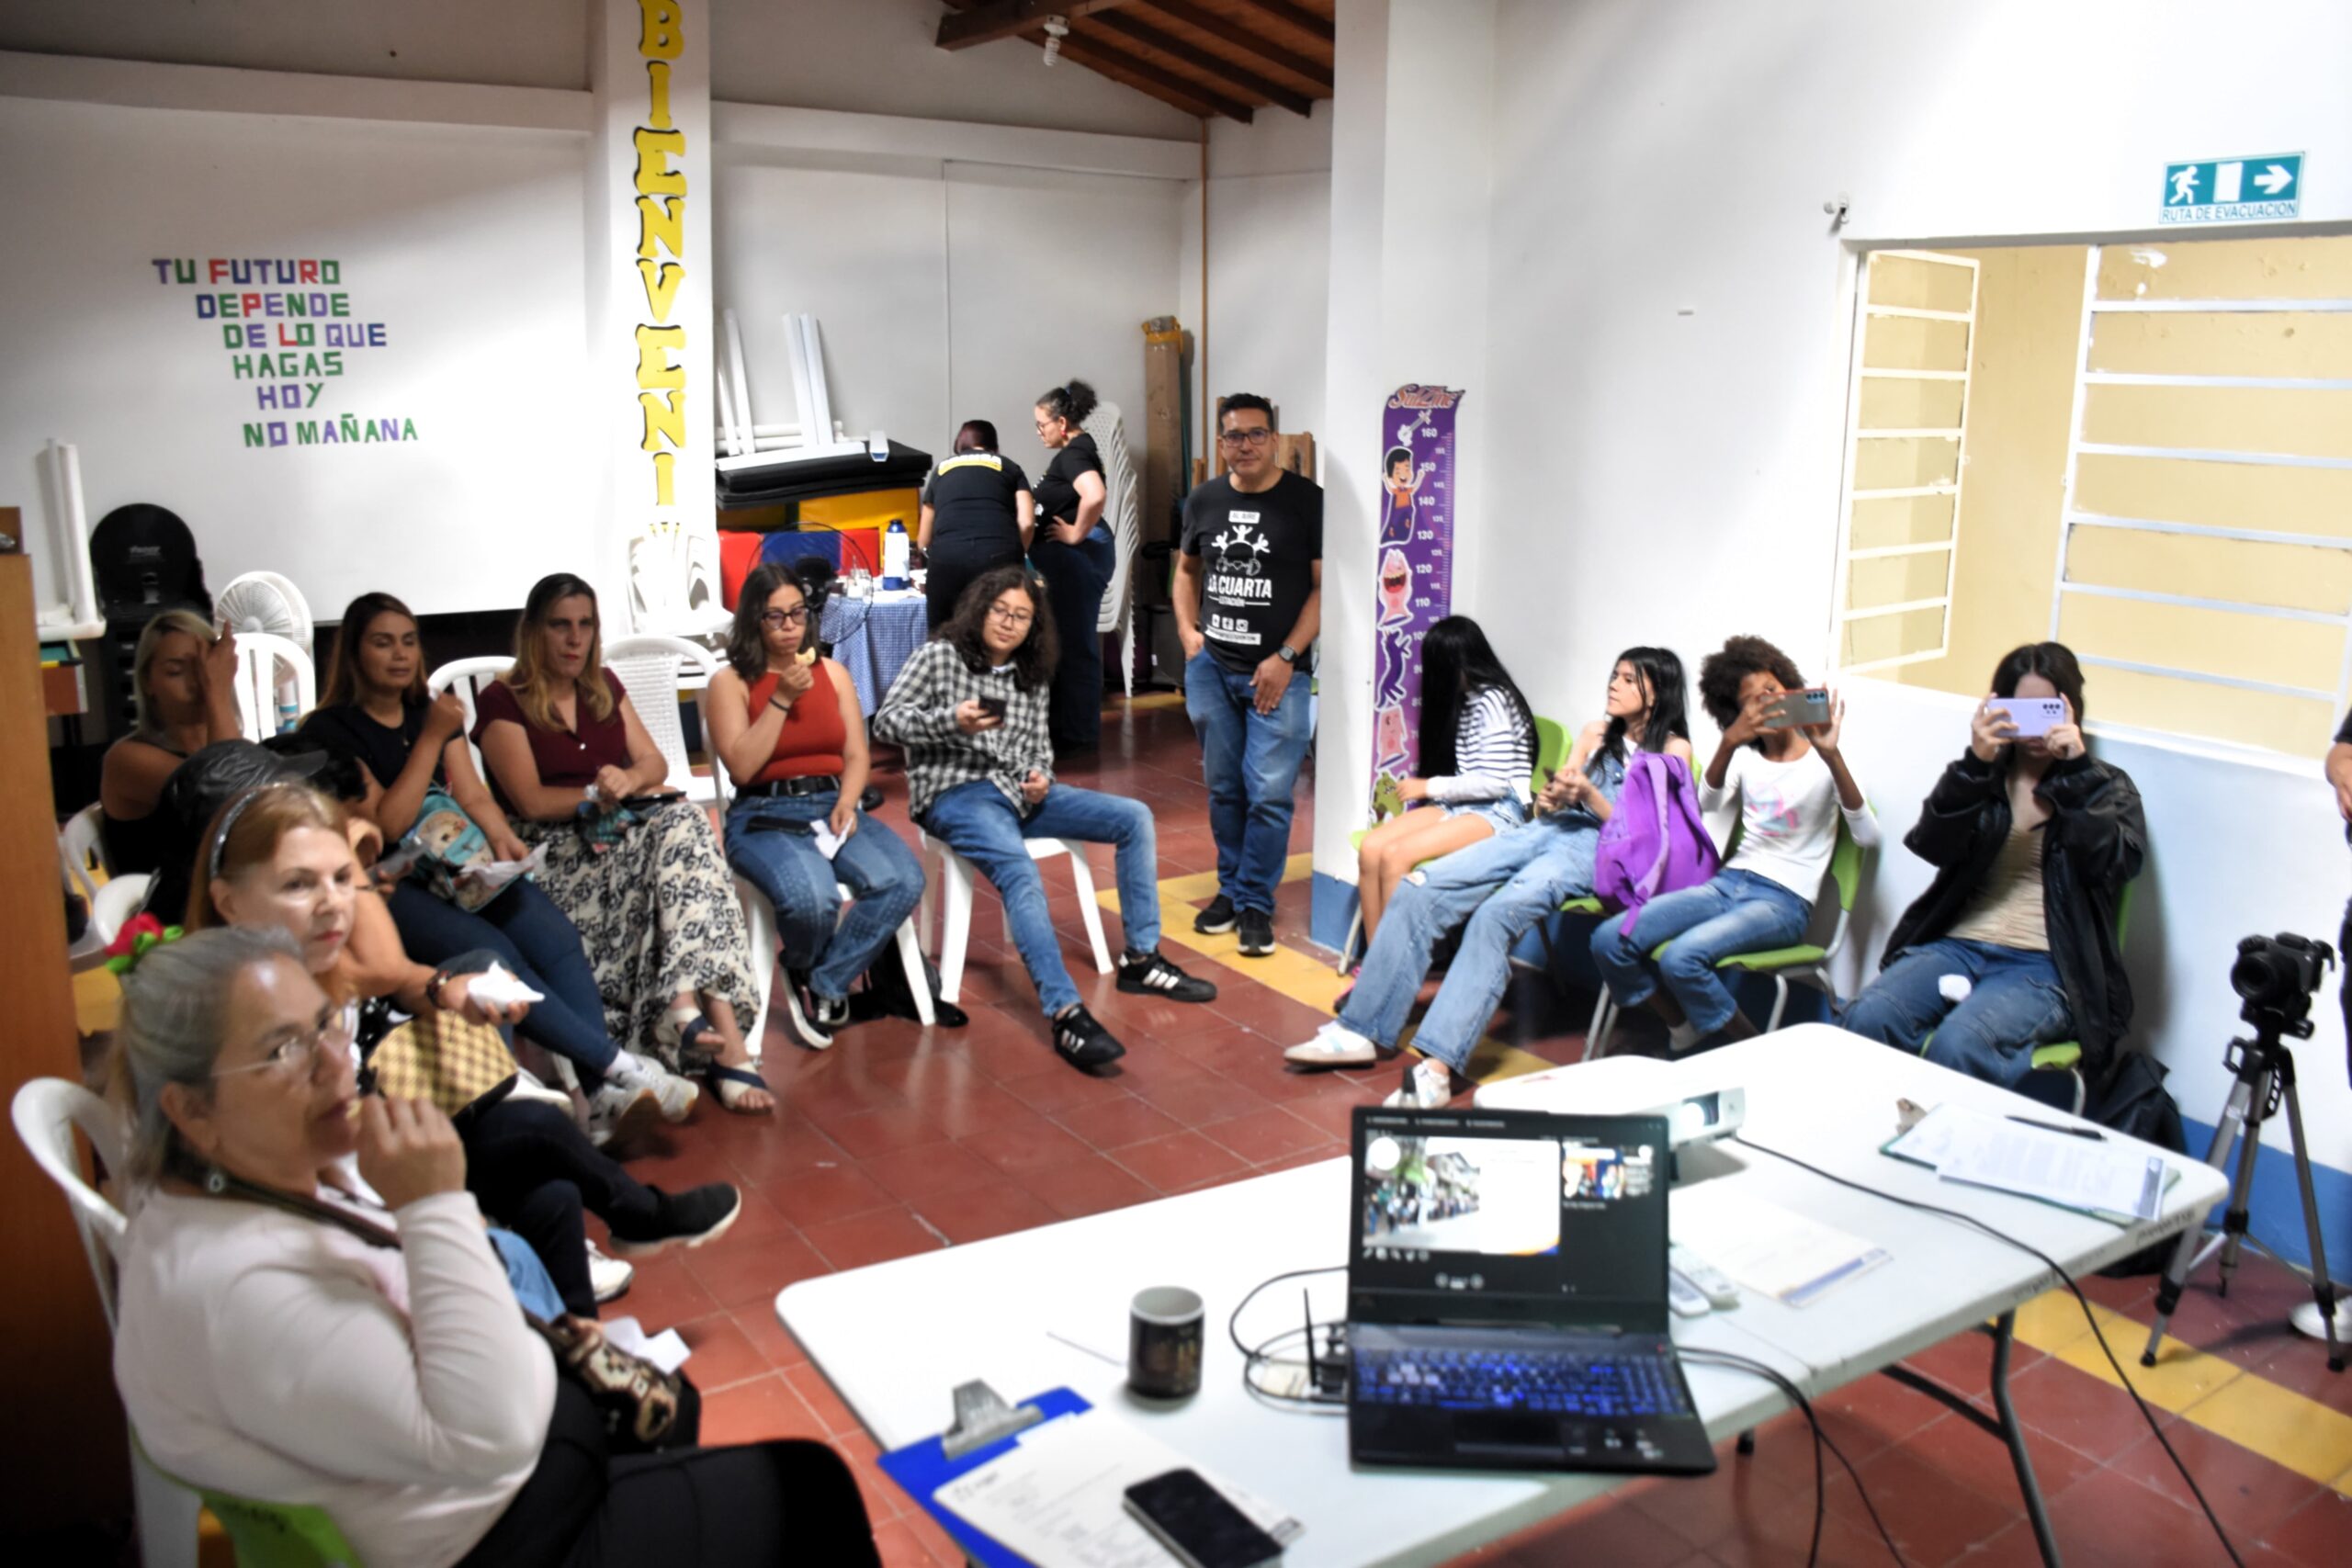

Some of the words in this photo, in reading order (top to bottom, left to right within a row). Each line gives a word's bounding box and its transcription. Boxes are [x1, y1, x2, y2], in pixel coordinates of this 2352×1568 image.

[2162, 208, 2193, 221] RUTA
[2196, 206, 2212, 220] DE
[152, 259, 197, 285] TU
[209, 259, 341, 285] FUTURO
[633, 0, 686, 534] BIENVENI
[196, 293, 350, 319] DEPENDE
[222, 323, 267, 349] DE
[278, 322, 315, 347] LO
[325, 322, 387, 348] QUE
[232, 351, 344, 379] HAGAS
[256, 382, 323, 411] HOY
[243, 421, 288, 447] NO
[296, 413, 418, 445] MAÑANA
[1420, 462, 1436, 472] 150
[1418, 496, 1435, 506] 140
[1417, 530, 1433, 540] 130
[1416, 564, 1432, 574] 120
[1218, 575, 1272, 599] CUARTA
[1415, 597, 1430, 607] 110
